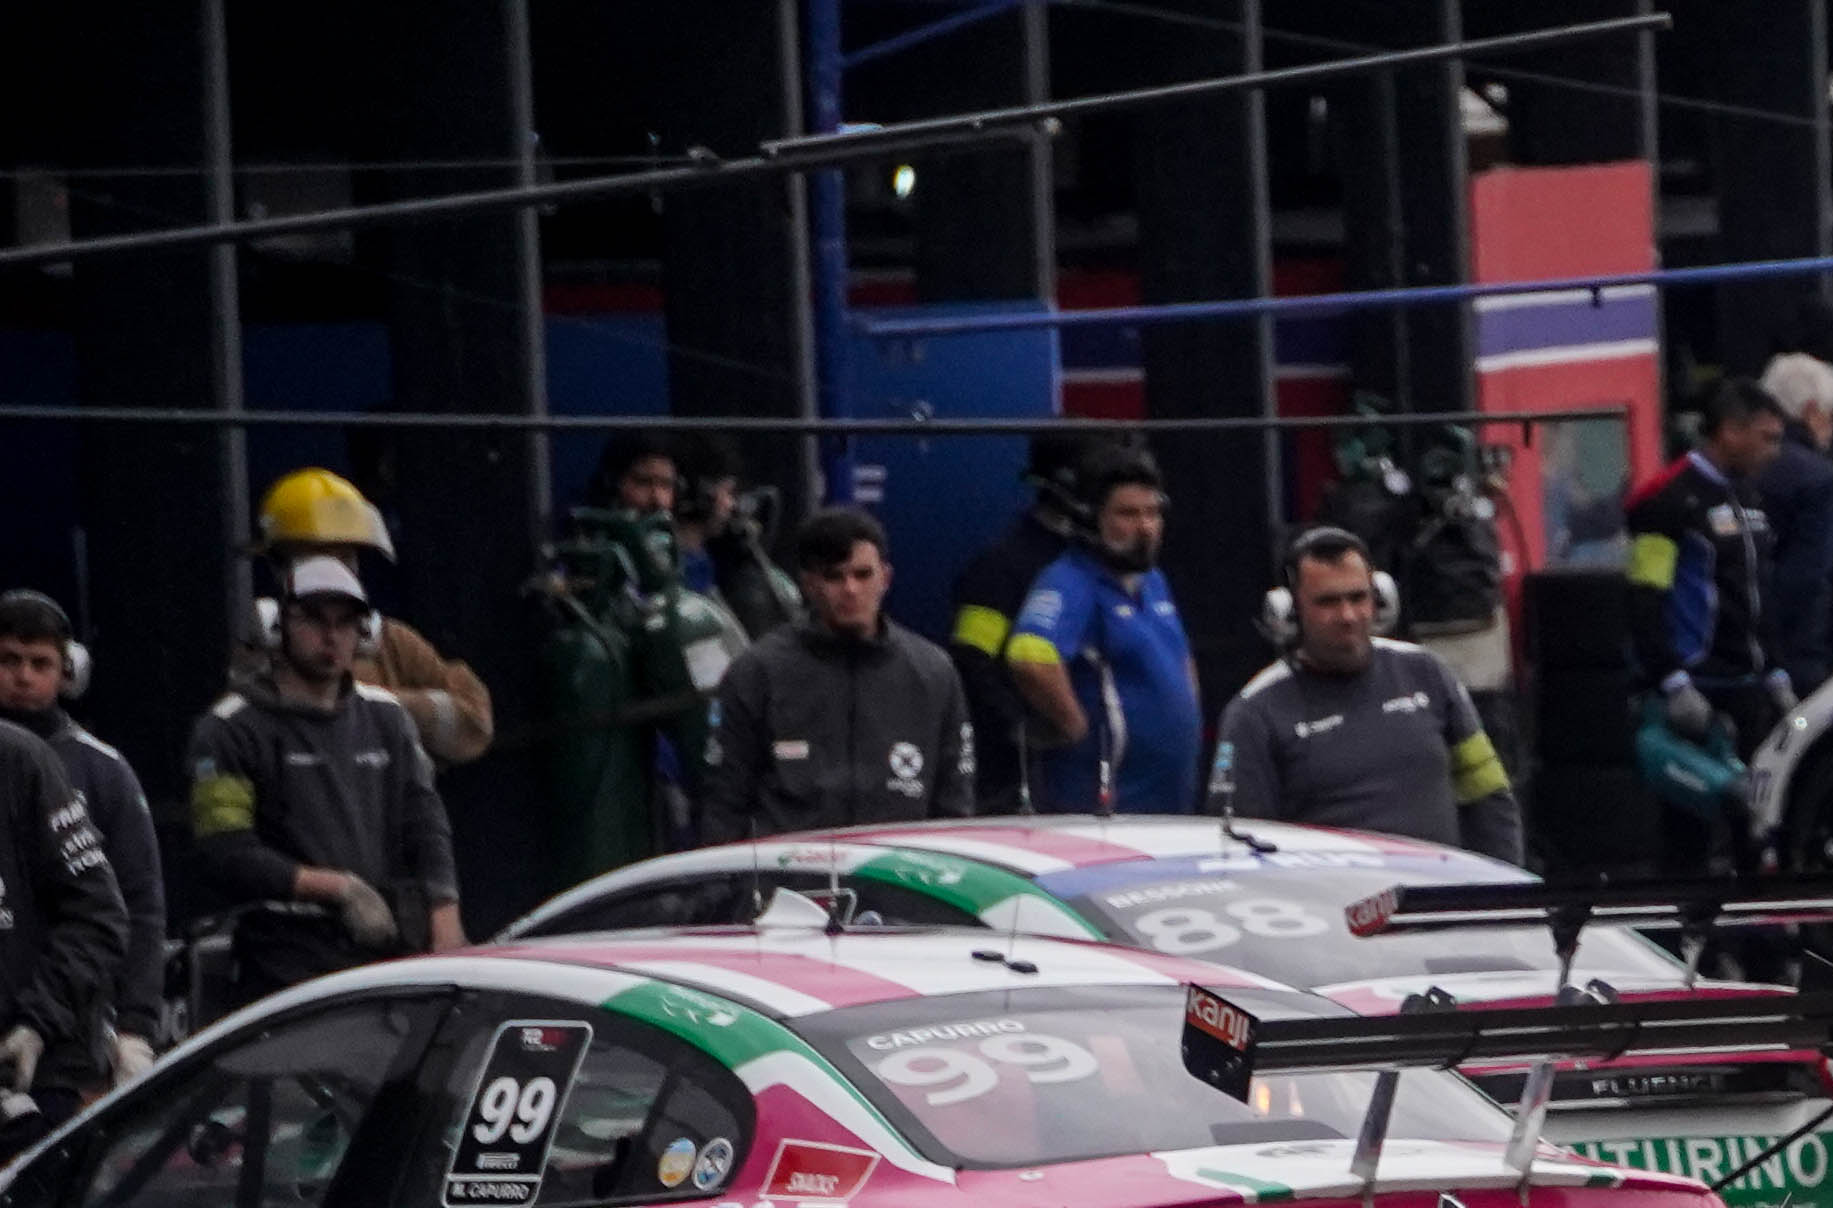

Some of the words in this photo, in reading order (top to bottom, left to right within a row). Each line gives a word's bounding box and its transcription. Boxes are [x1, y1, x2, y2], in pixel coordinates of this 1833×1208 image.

[1133, 899, 1331, 956] 88
[867, 1017, 1027, 1053] CAPURRO
[1187, 989, 1250, 1052] kanji
[876, 1030, 1100, 1108] 99
[471, 1075, 558, 1145] 99
